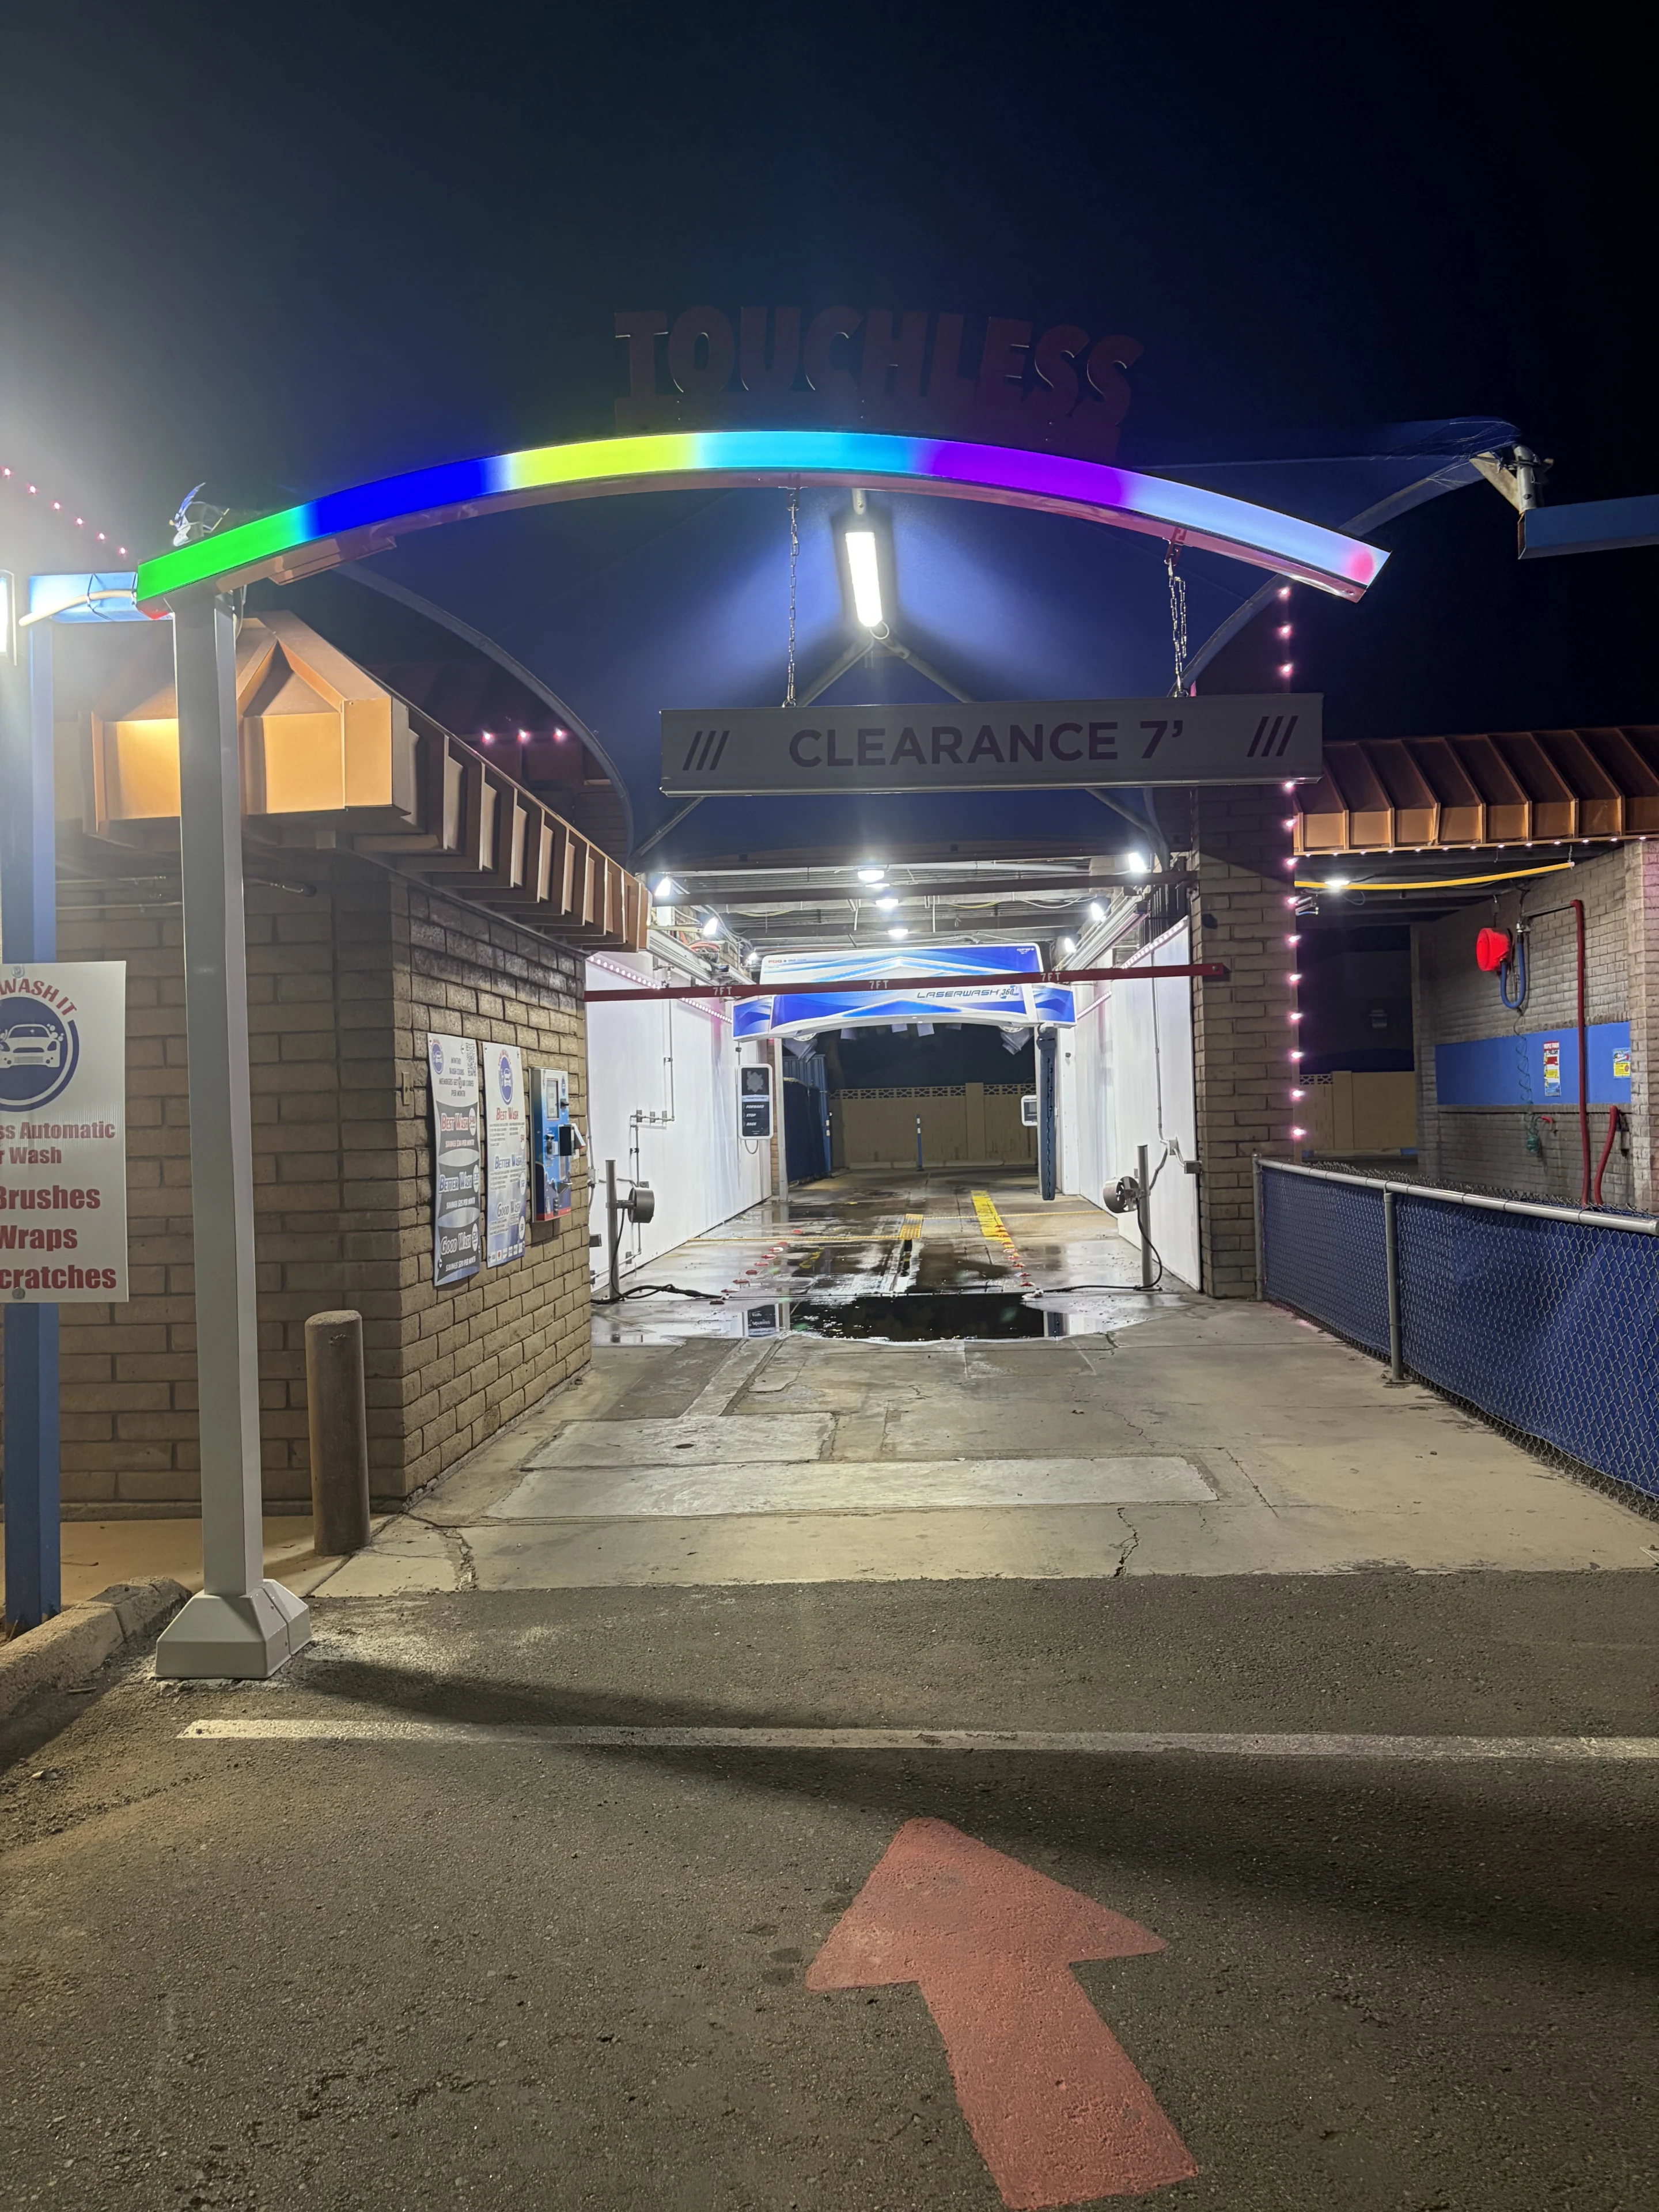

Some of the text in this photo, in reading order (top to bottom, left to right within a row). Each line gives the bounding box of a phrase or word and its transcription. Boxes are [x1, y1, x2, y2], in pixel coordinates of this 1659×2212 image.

[613, 305, 1145, 425] TOUCHLESS
[789, 722, 1118, 768] CLEARANCE
[0, 978, 77, 1016] WASH IT
[916, 987, 1015, 999] LASERWASH 360
[20, 1121, 115, 1139] Automatic
[9, 1146, 62, 1164] Wash
[0, 1225, 78, 1252] Wraps
[0, 1265, 116, 1289] cratches
